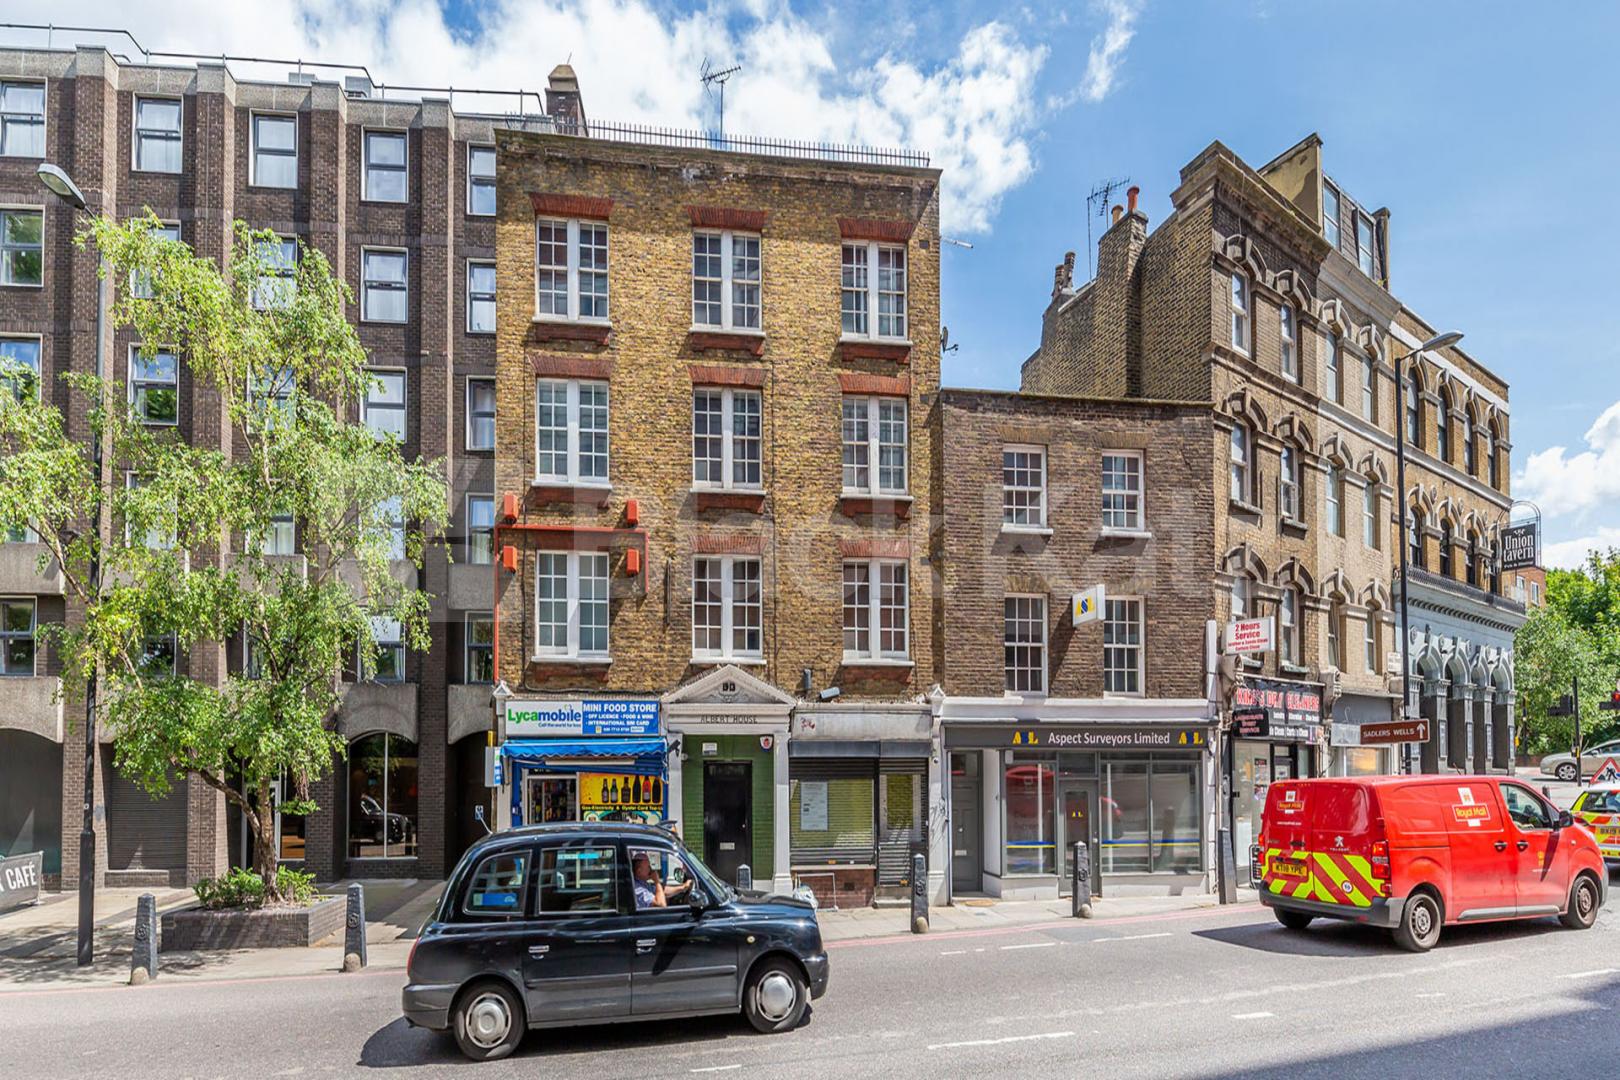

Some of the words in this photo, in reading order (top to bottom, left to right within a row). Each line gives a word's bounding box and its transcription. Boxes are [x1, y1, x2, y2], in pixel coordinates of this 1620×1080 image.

[1505, 534, 1534, 550] Union
[1503, 547, 1534, 562] tavern
[1235, 623, 1239, 632] 2
[1241, 622, 1261, 631] Hours
[1235, 631, 1260, 640] Service
[583, 703, 601, 712] MINI
[603, 703, 627, 712] FOOD
[629, 703, 657, 712] STORE
[507, 704, 582, 724] Lycamobile
[700, 715, 730, 724] ALBERT
[733, 715, 758, 724] HOUSE
[1392, 728, 1415, 736] WELLS
[1048, 732, 1082, 746] Aspect
[1083, 732, 1132, 747] Surveyors
[1134, 732, 1170, 744] Limited
[1455, 808, 1473, 818] Royal
[1473, 807, 1487, 816] Mail
[5, 861, 37, 890] CAFÉ
